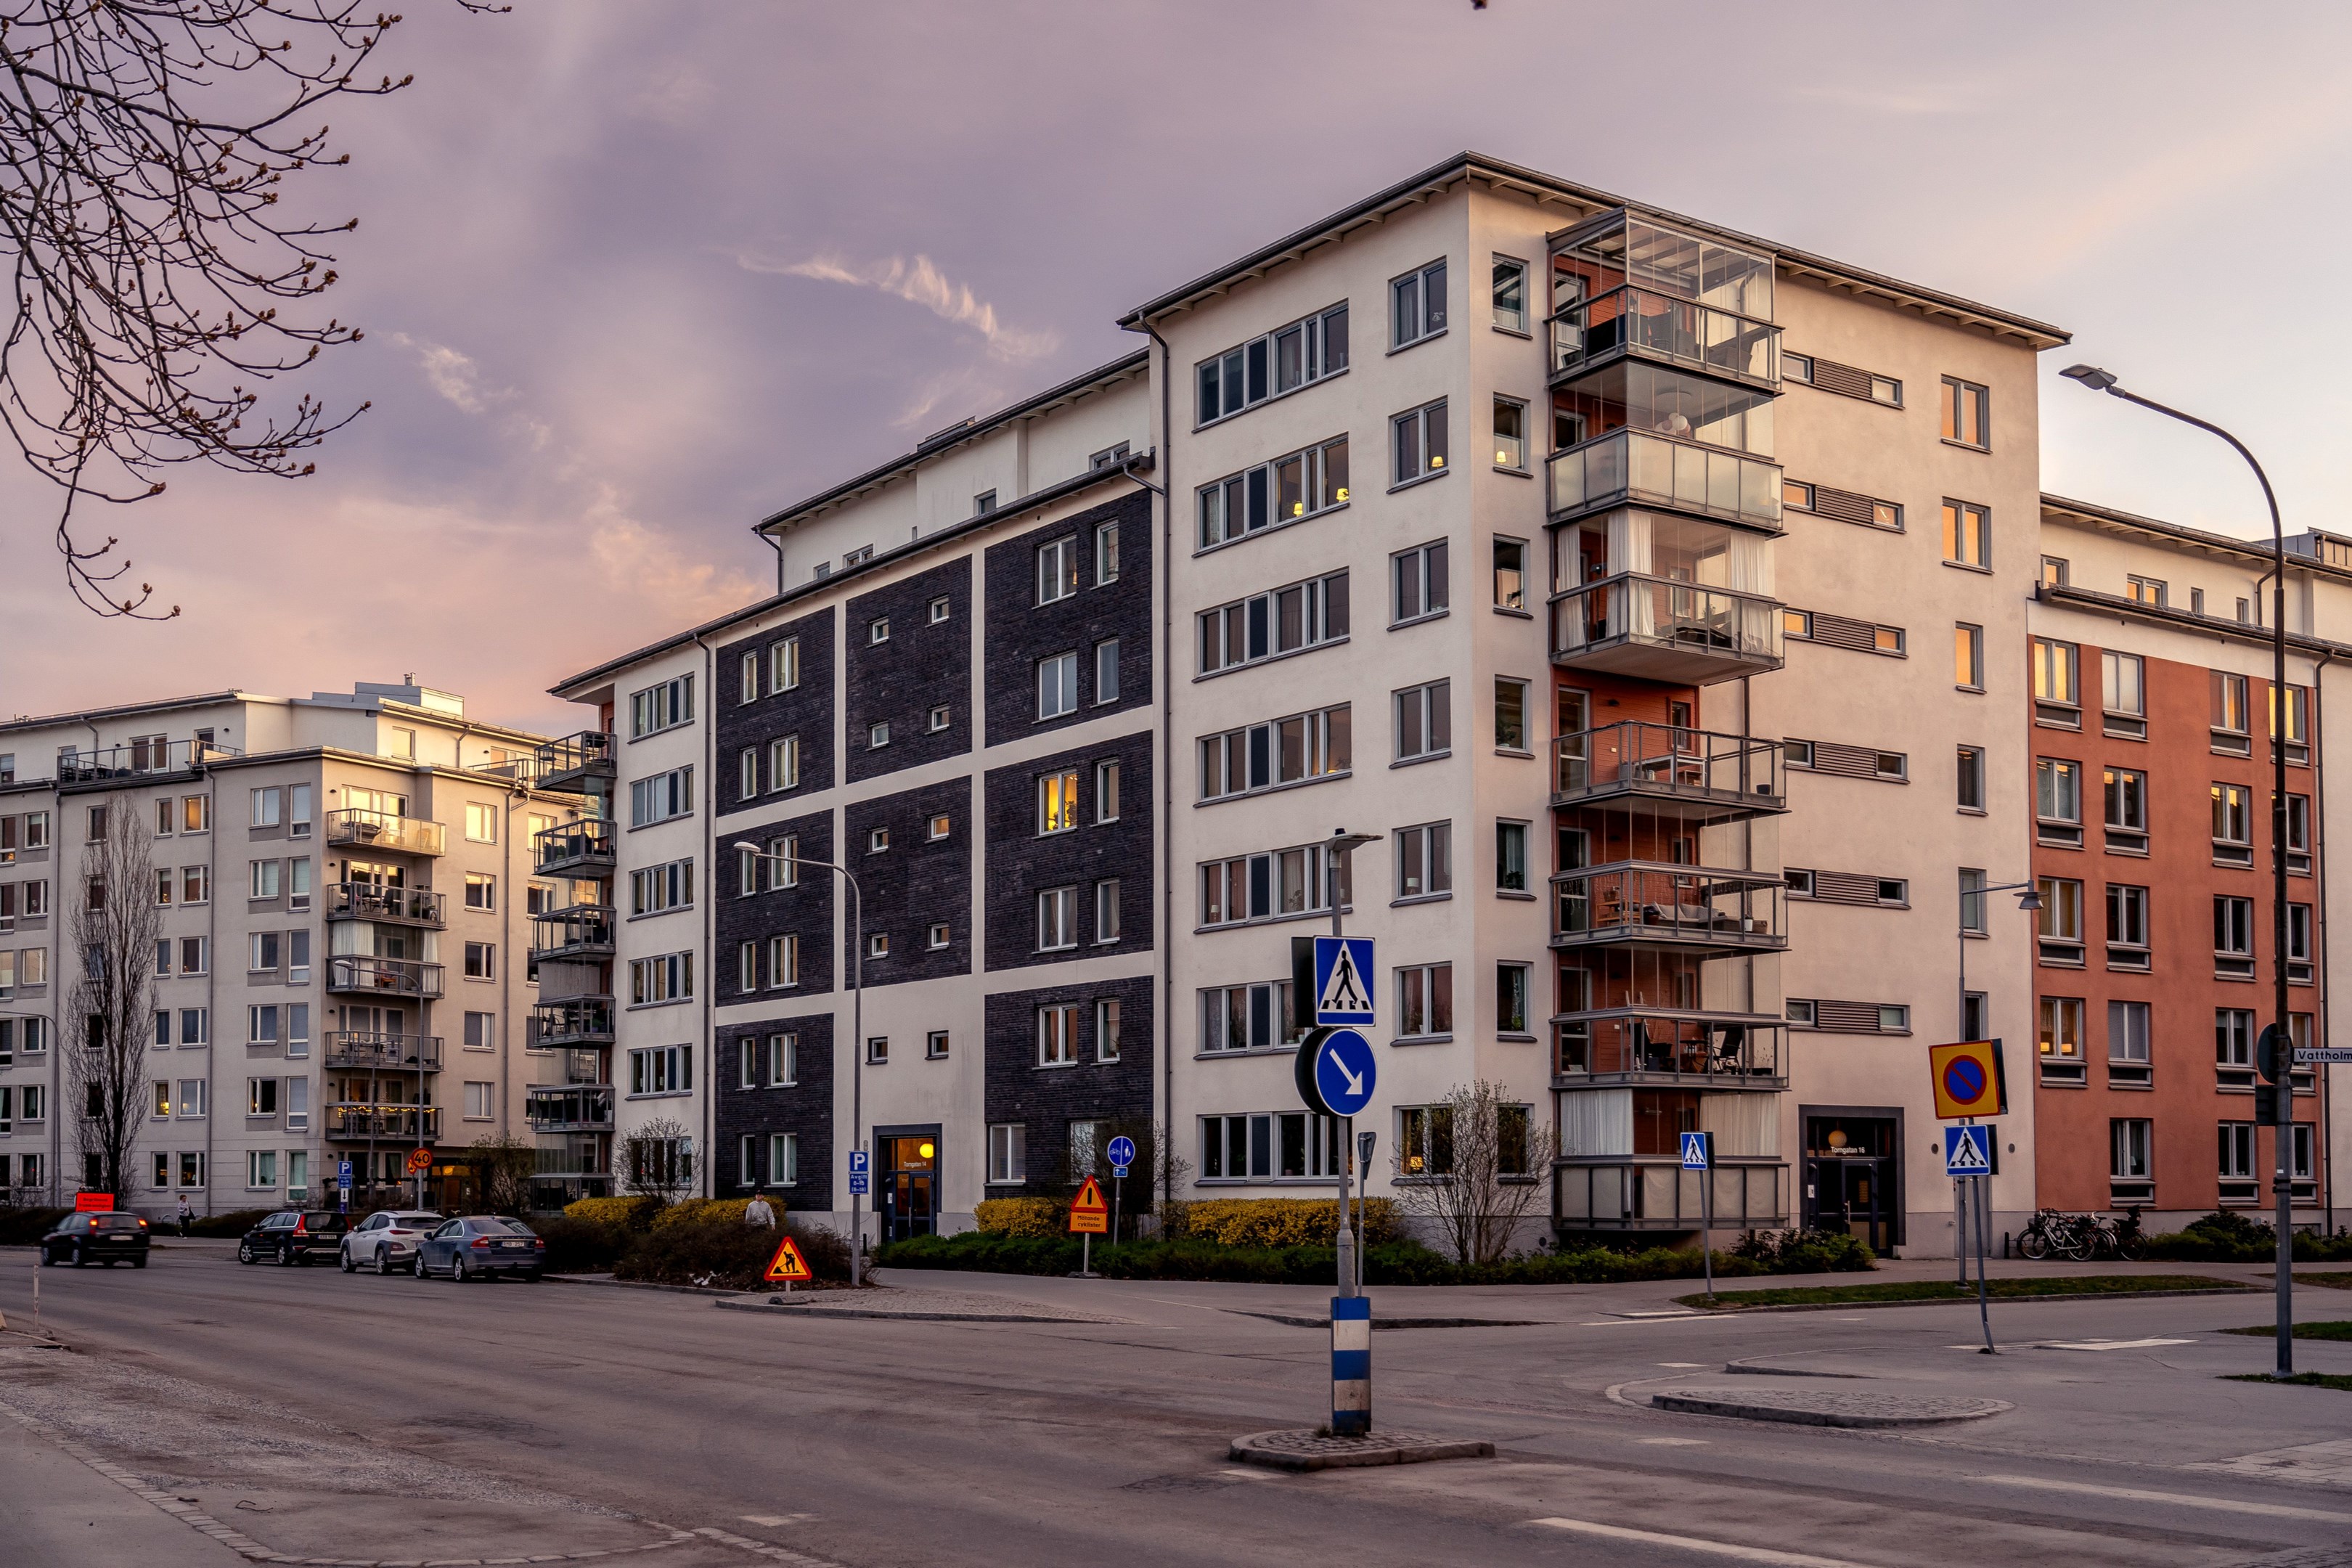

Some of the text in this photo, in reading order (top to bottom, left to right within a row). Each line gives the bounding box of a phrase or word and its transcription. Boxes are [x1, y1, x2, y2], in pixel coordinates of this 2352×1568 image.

[415, 1153, 430, 1164] 40
[854, 1153, 865, 1170] P
[341, 1162, 350, 1173] P
